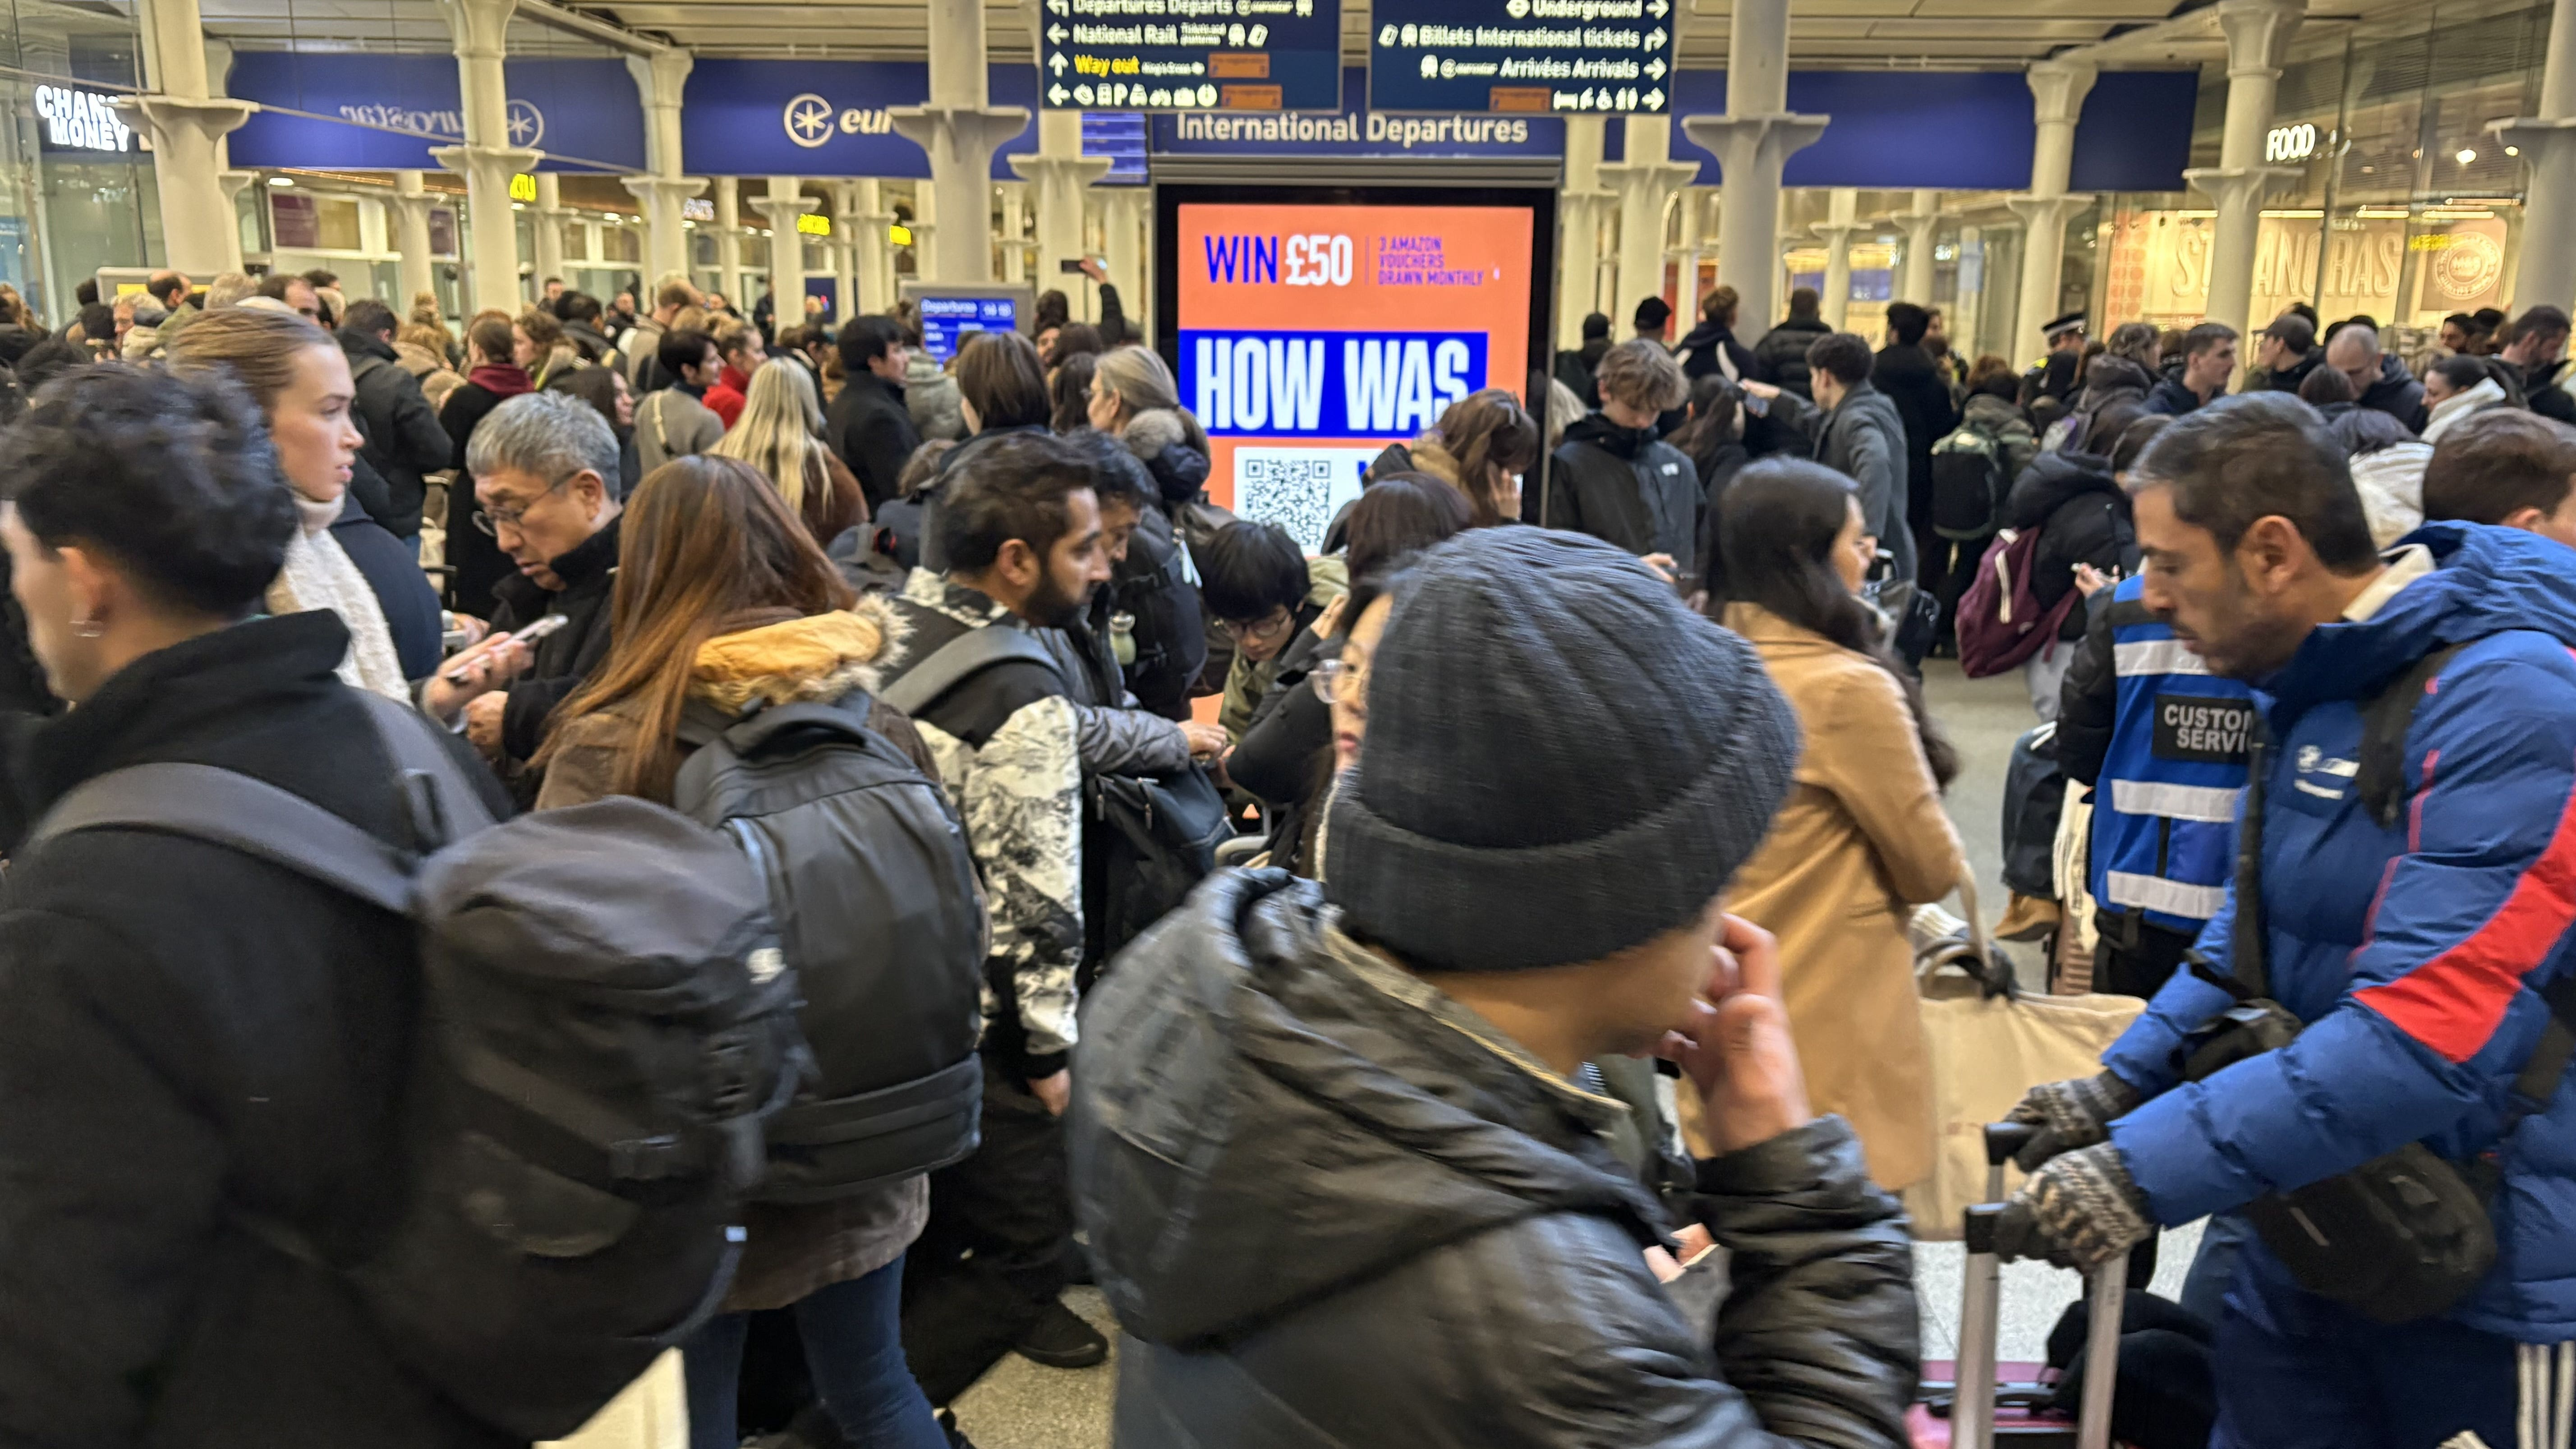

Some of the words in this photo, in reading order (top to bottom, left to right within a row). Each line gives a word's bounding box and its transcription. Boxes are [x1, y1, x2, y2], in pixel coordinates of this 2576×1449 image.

[1532, 0, 1643, 22] Underground
[1073, 23, 1143, 45] National
[1145, 24, 1178, 45] Rail
[1420, 25, 1474, 47] Billets
[1476, 25, 1582, 47] International
[1583, 27, 1641, 48] tickets
[1074, 54, 1110, 78] Way
[1112, 55, 1140, 75] out
[1500, 56, 1571, 78] Arrivées
[1572, 57, 1639, 79] Arrivals
[49, 115, 129, 152] MONEY
[1177, 112, 1359, 142] International
[1366, 113, 1528, 148] Departures
[2266, 124, 2315, 161] FOOD
[1390, 236, 1442, 252] AMAZON
[1204, 235, 1277, 284] WIN
[1285, 234, 1353, 286] £50
[1379, 253, 1444, 268] VOUCHERS
[1379, 270, 1423, 285] DRAWN
[1426, 270, 1484, 286] MONTHLY
[1196, 337, 1325, 431] HOW
[1344, 339, 1470, 431] WAS
[2176, 727, 2252, 754] SERVI
